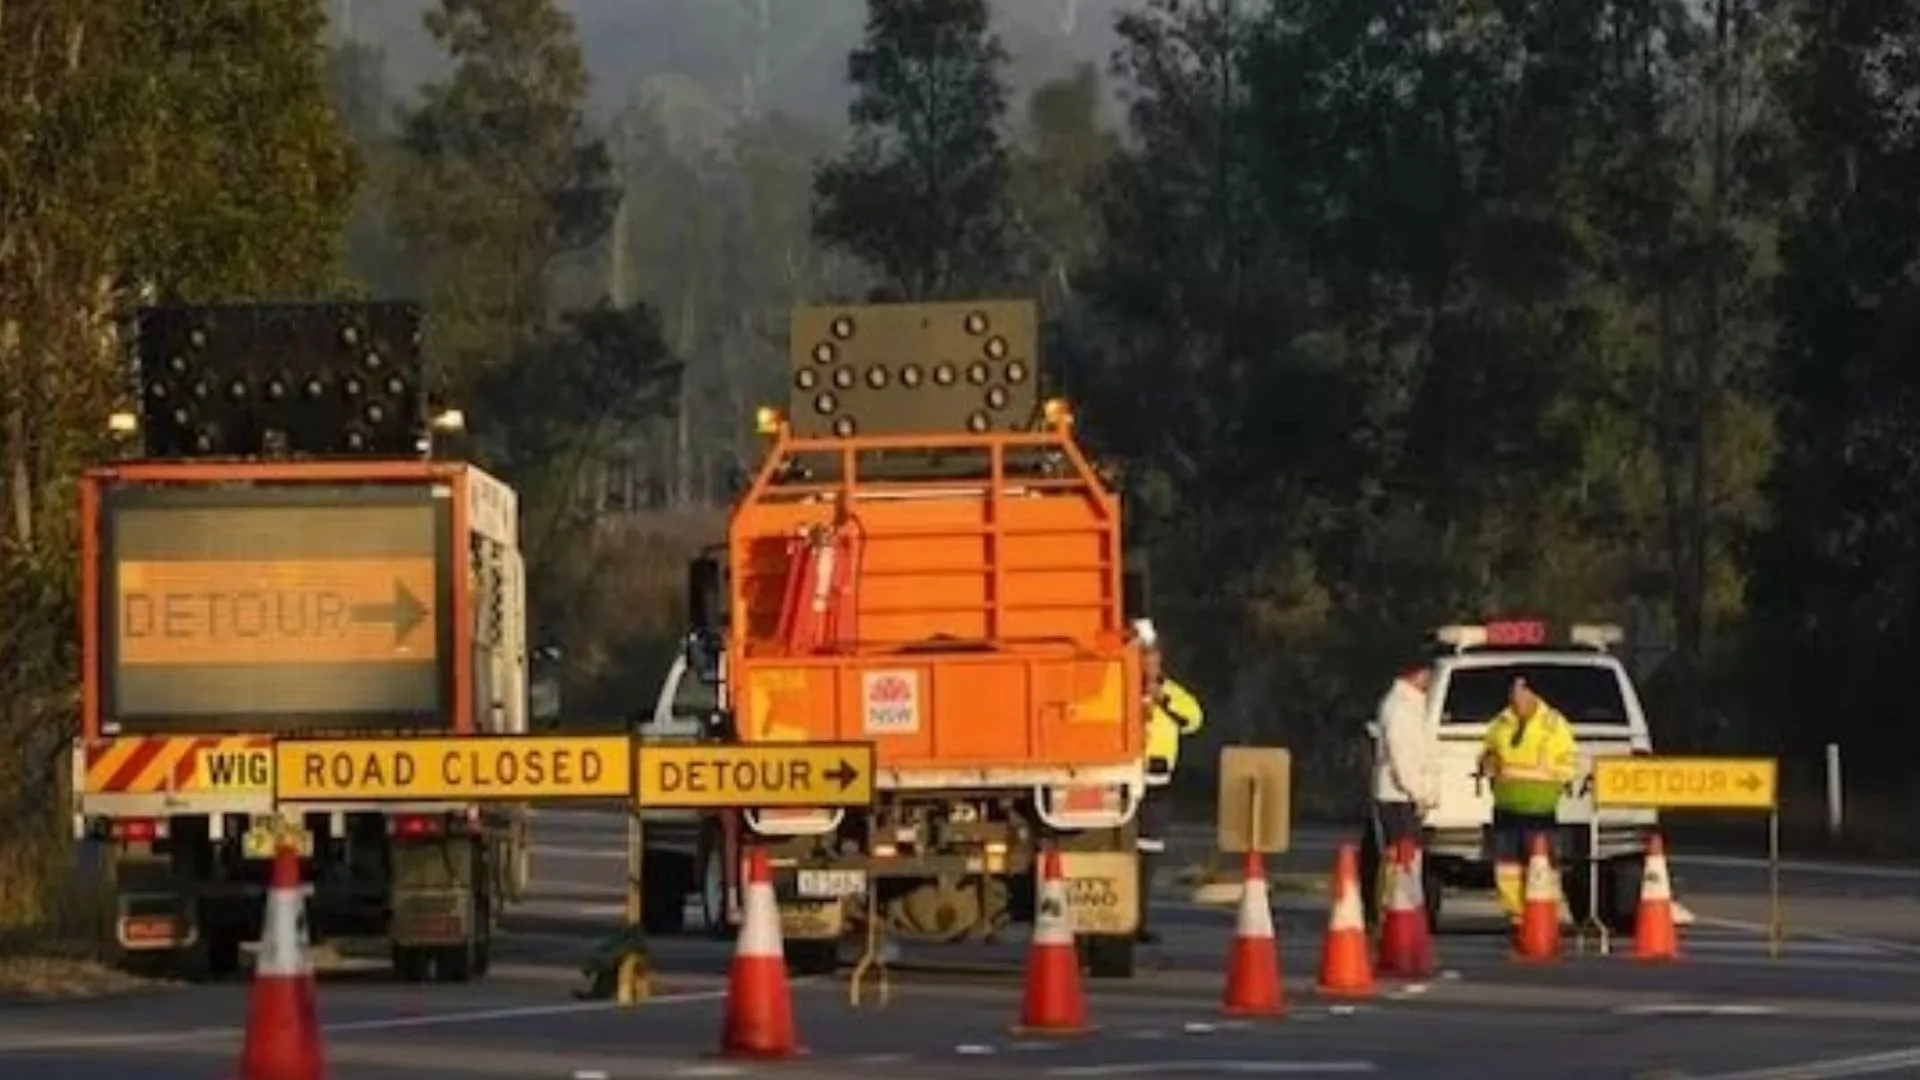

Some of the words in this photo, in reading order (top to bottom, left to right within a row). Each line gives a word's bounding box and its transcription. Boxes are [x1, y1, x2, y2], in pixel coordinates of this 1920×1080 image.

[125, 593, 347, 638] DETOUR
[206, 752, 268, 785] WIG
[304, 752, 416, 788] ROAD
[442, 748, 603, 786] CLOSED
[659, 759, 812, 792] DETOUR
[1610, 767, 1728, 794] DETOUR
